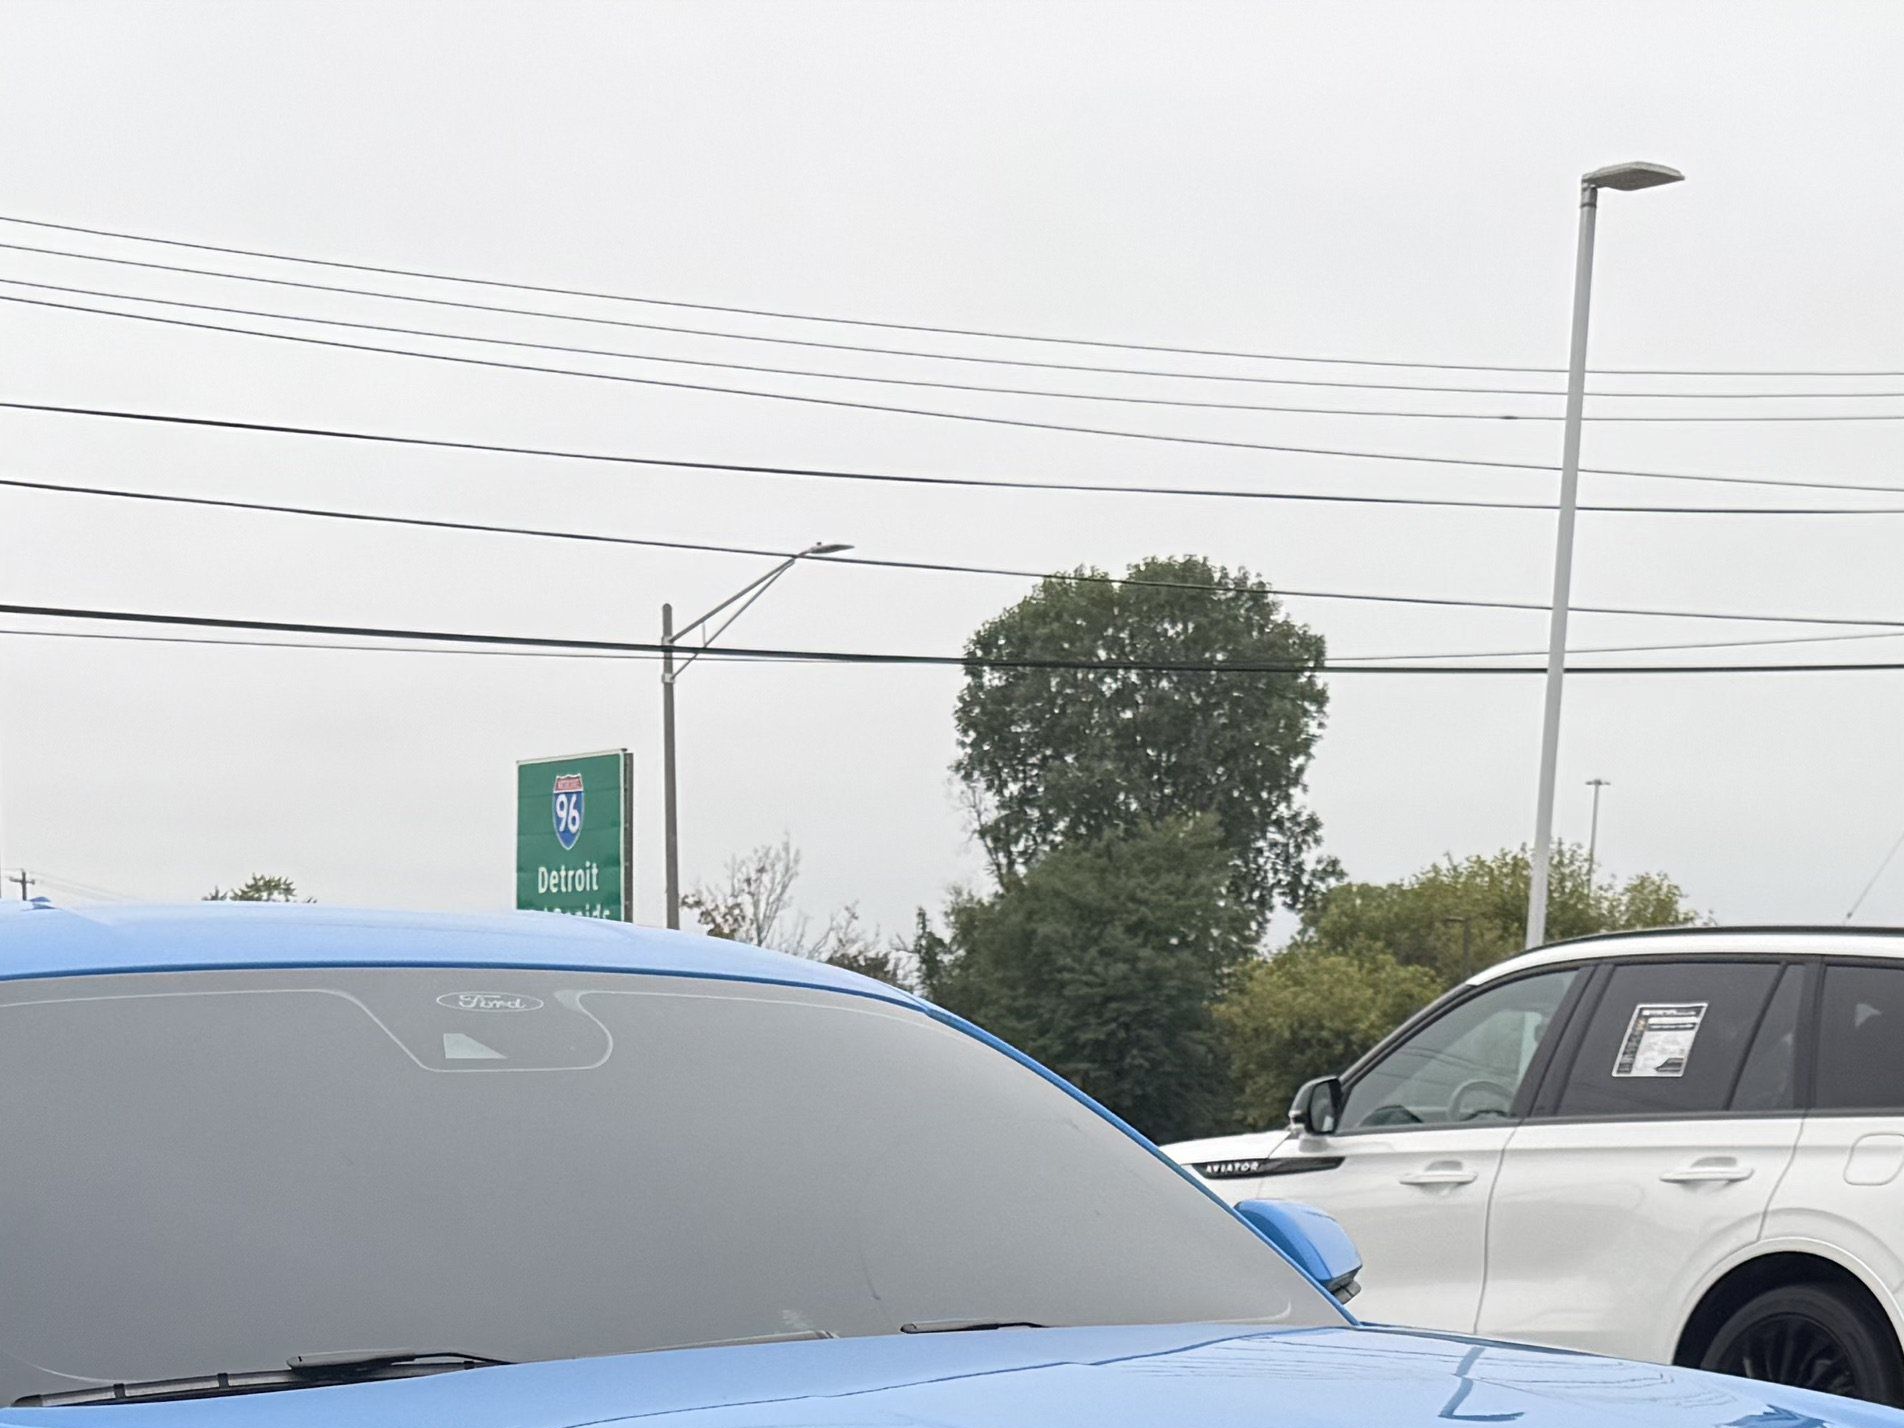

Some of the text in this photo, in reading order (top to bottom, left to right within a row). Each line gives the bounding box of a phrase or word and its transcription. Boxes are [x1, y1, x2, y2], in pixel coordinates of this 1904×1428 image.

[556, 793, 580, 834] 96
[537, 861, 599, 894] Detroit
[458, 995, 527, 1009] Ford
[1206, 1161, 1259, 1174] AVIATOR
